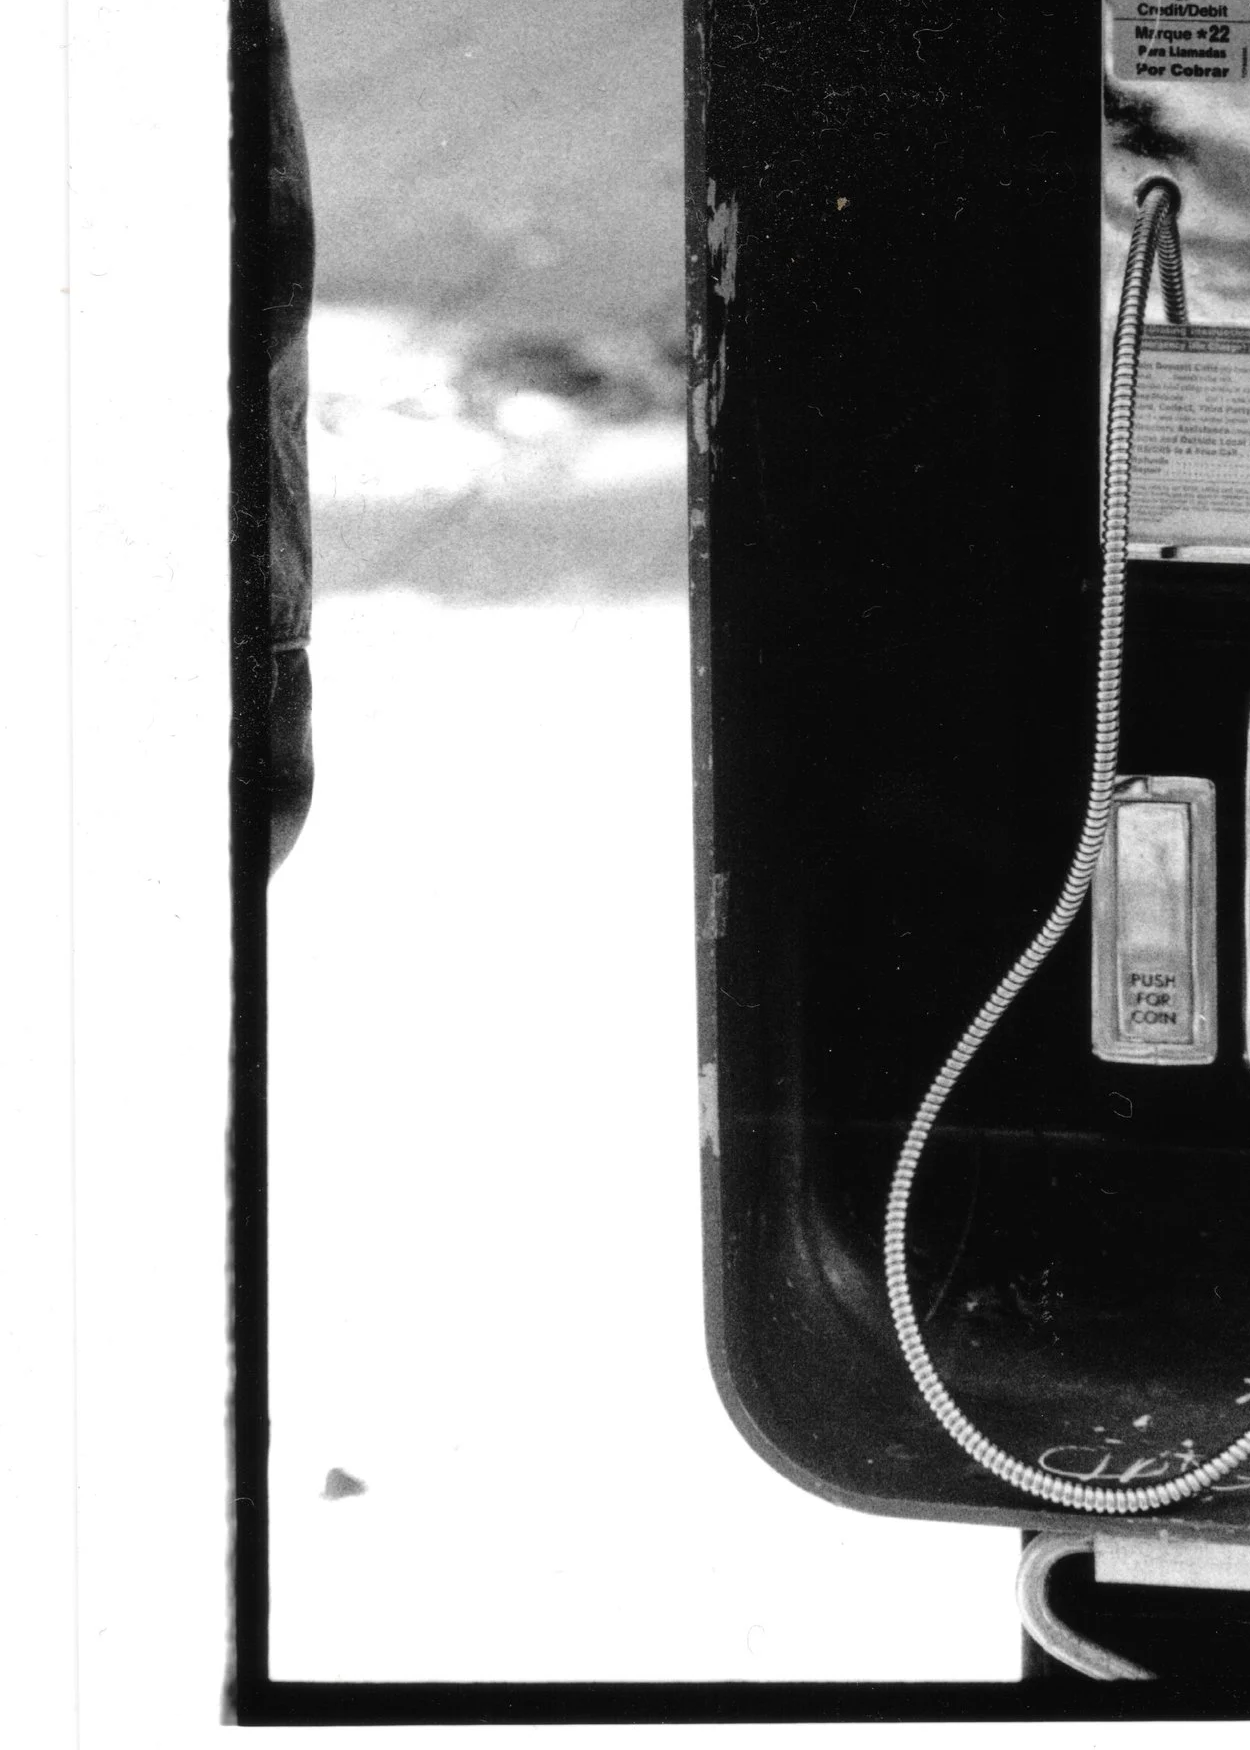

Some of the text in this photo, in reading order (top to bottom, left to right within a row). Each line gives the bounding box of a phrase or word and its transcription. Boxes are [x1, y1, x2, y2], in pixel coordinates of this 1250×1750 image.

[1137, 3, 1229, 18] Credit/Debit
[1135, 26, 1193, 44] Marque
[1138, 45, 1227, 59] Para Llamadas
[1136, 62, 1166, 77] Por
[1171, 63, 1230, 78] Cobrar
[1131, 974, 1177, 988] PUSH
[1136, 993, 1171, 1006] FOR
[1131, 1010, 1177, 1025] COIN
